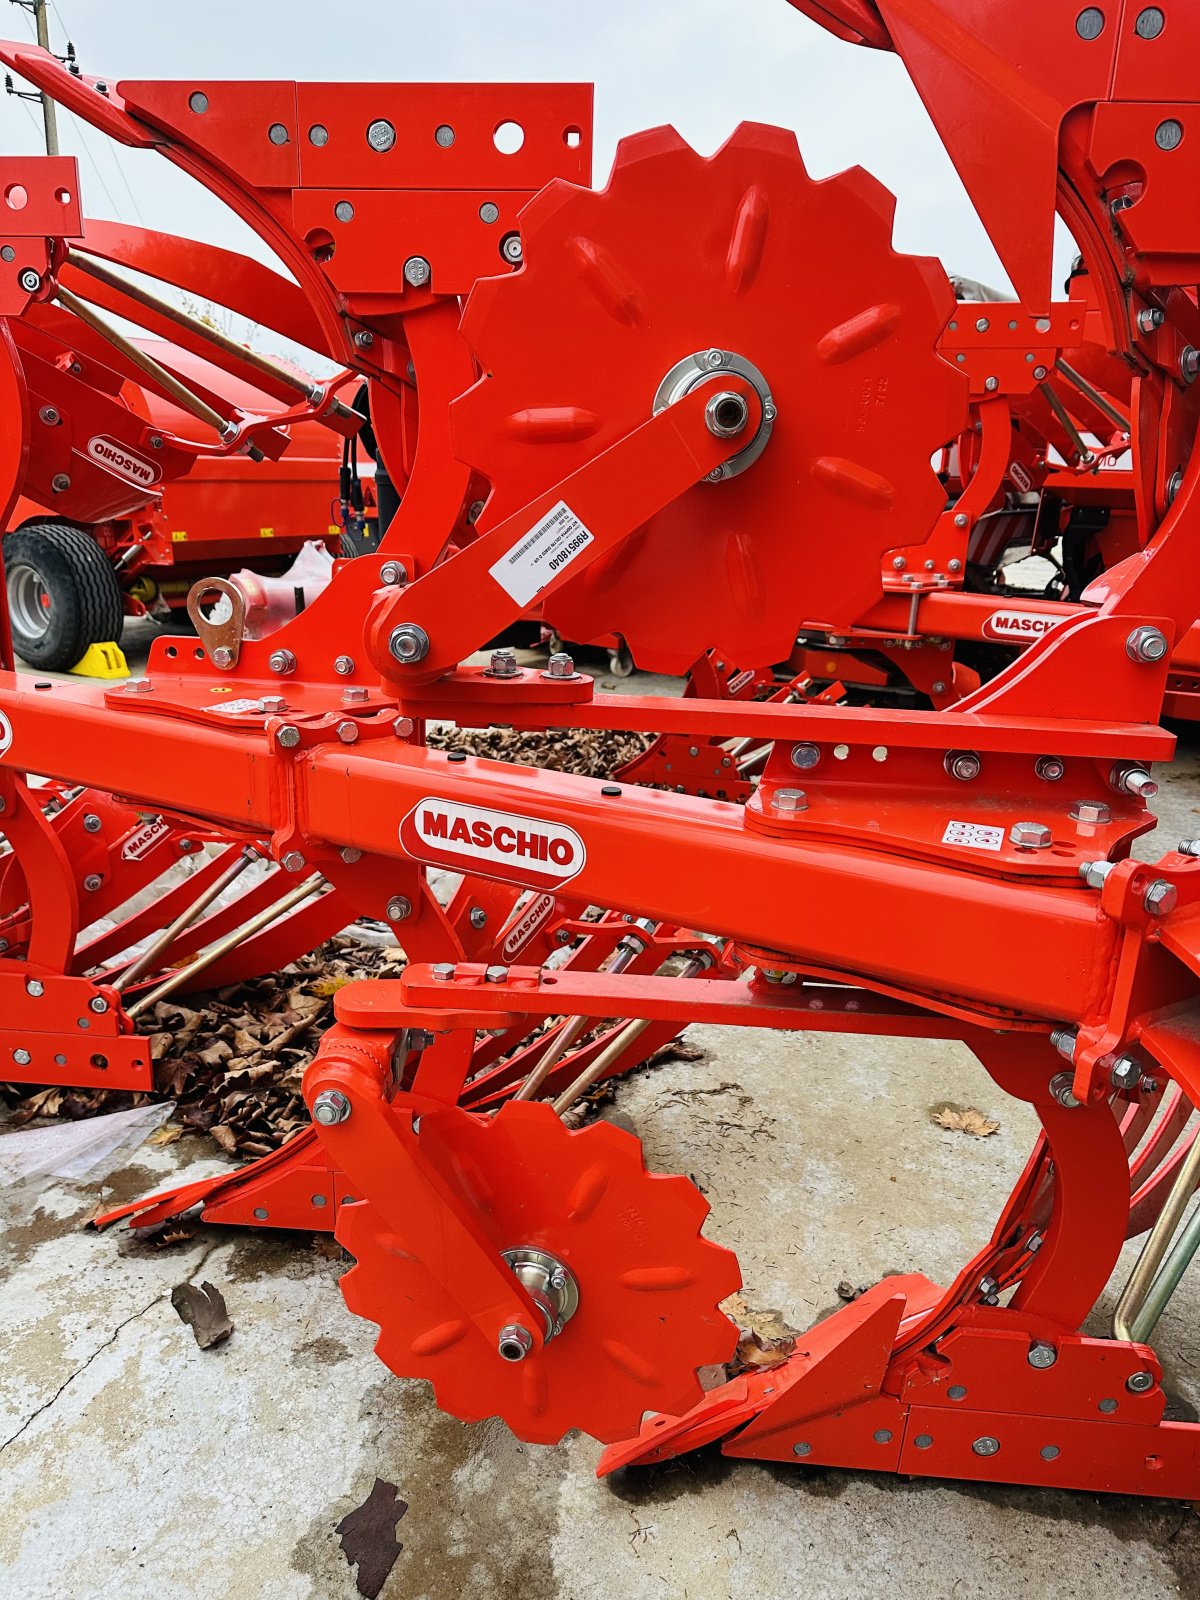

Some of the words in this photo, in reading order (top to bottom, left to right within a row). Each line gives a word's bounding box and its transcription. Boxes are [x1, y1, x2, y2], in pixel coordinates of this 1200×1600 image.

[94, 443, 151, 481] MASCHIO
[548, 531, 589, 570] R99518040
[995, 617, 1056, 633] MASCH
[127, 819, 166, 853] MASCH
[423, 810, 575, 866] MASCHIO
[508, 896, 551, 949] MASCHIO
